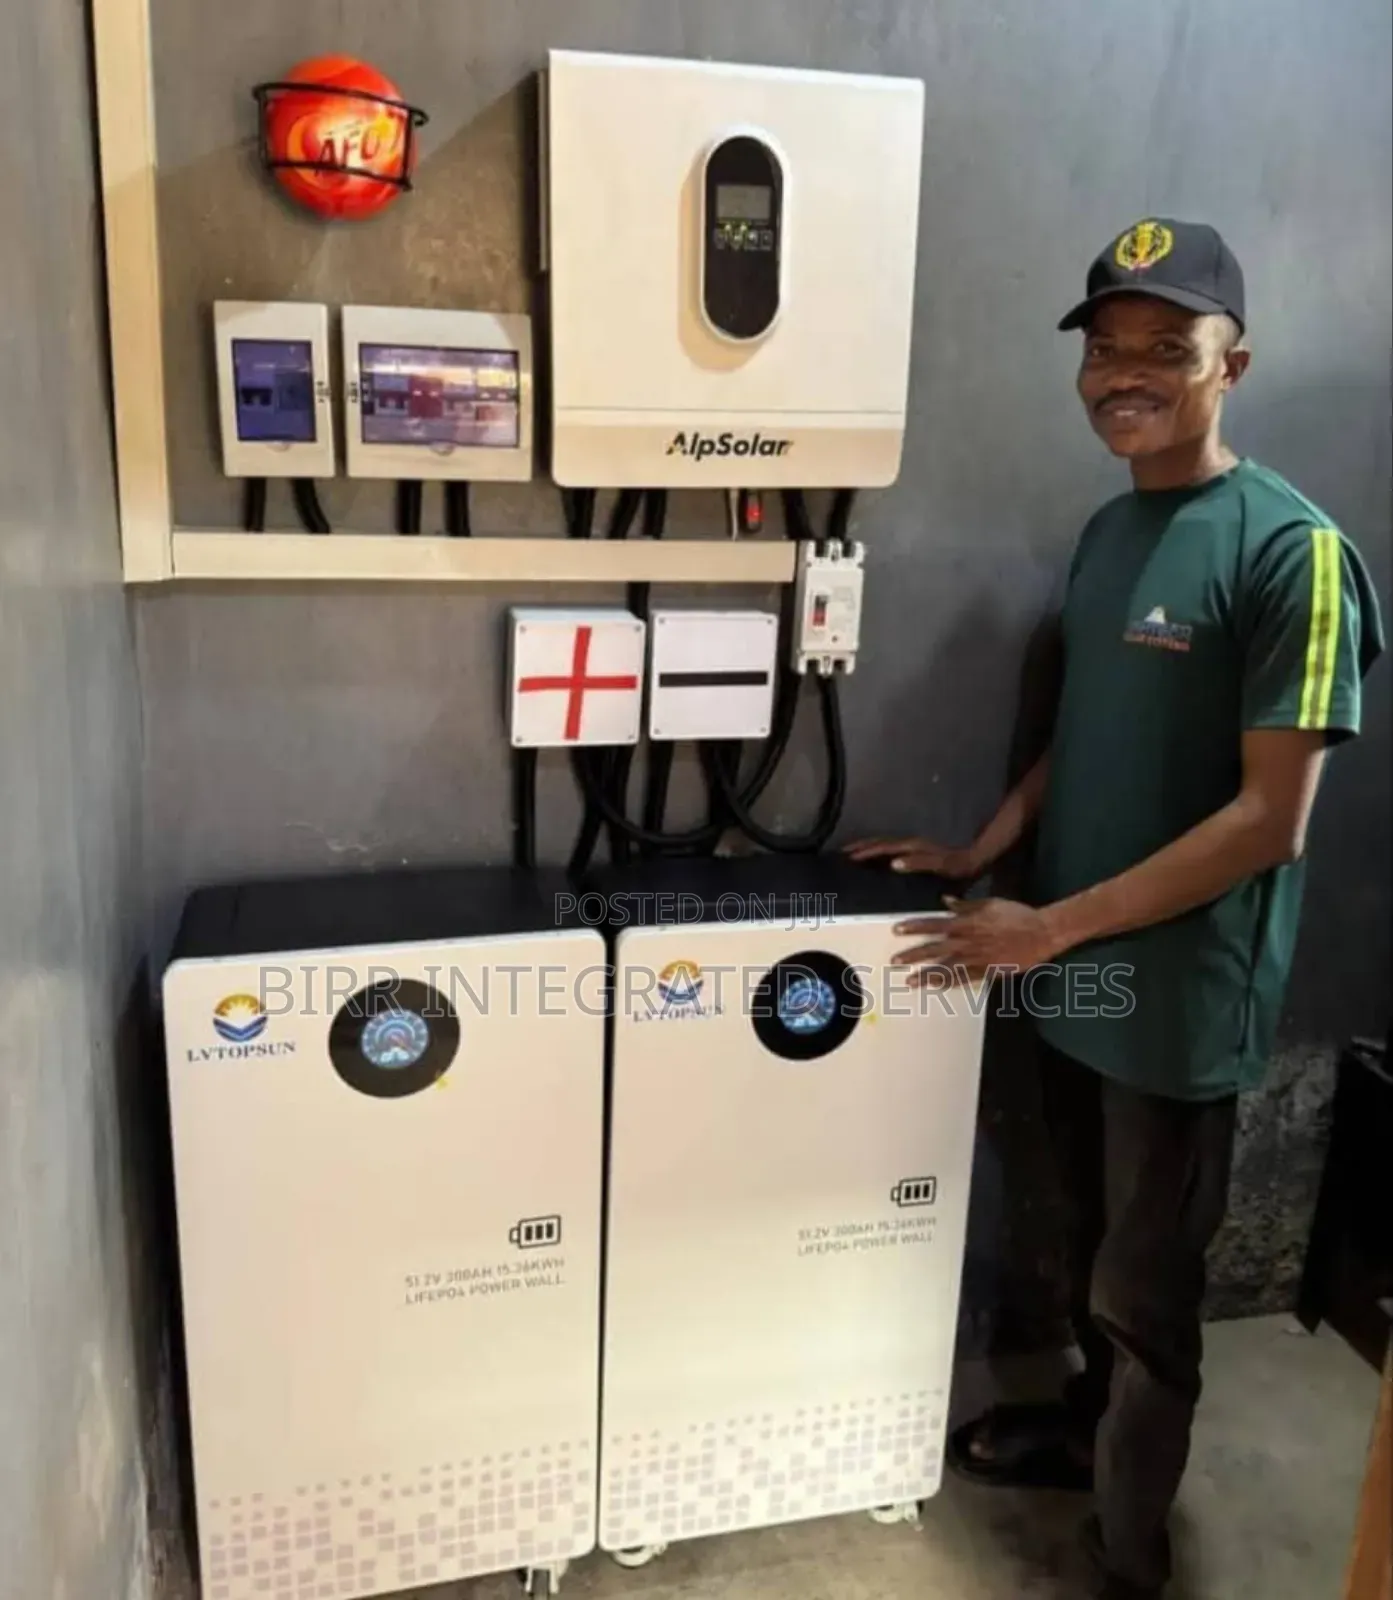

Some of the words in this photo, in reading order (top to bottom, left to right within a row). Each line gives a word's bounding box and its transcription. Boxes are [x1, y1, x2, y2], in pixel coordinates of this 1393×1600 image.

[314, 126, 381, 175] AFO
[666, 431, 794, 461] AlpSolar
[187, 1041, 296, 1062] LVTOPSUN
[901, 1231, 933, 1244] WALL
[469, 1278, 521, 1296] POWER
[524, 1272, 567, 1288] WALL
